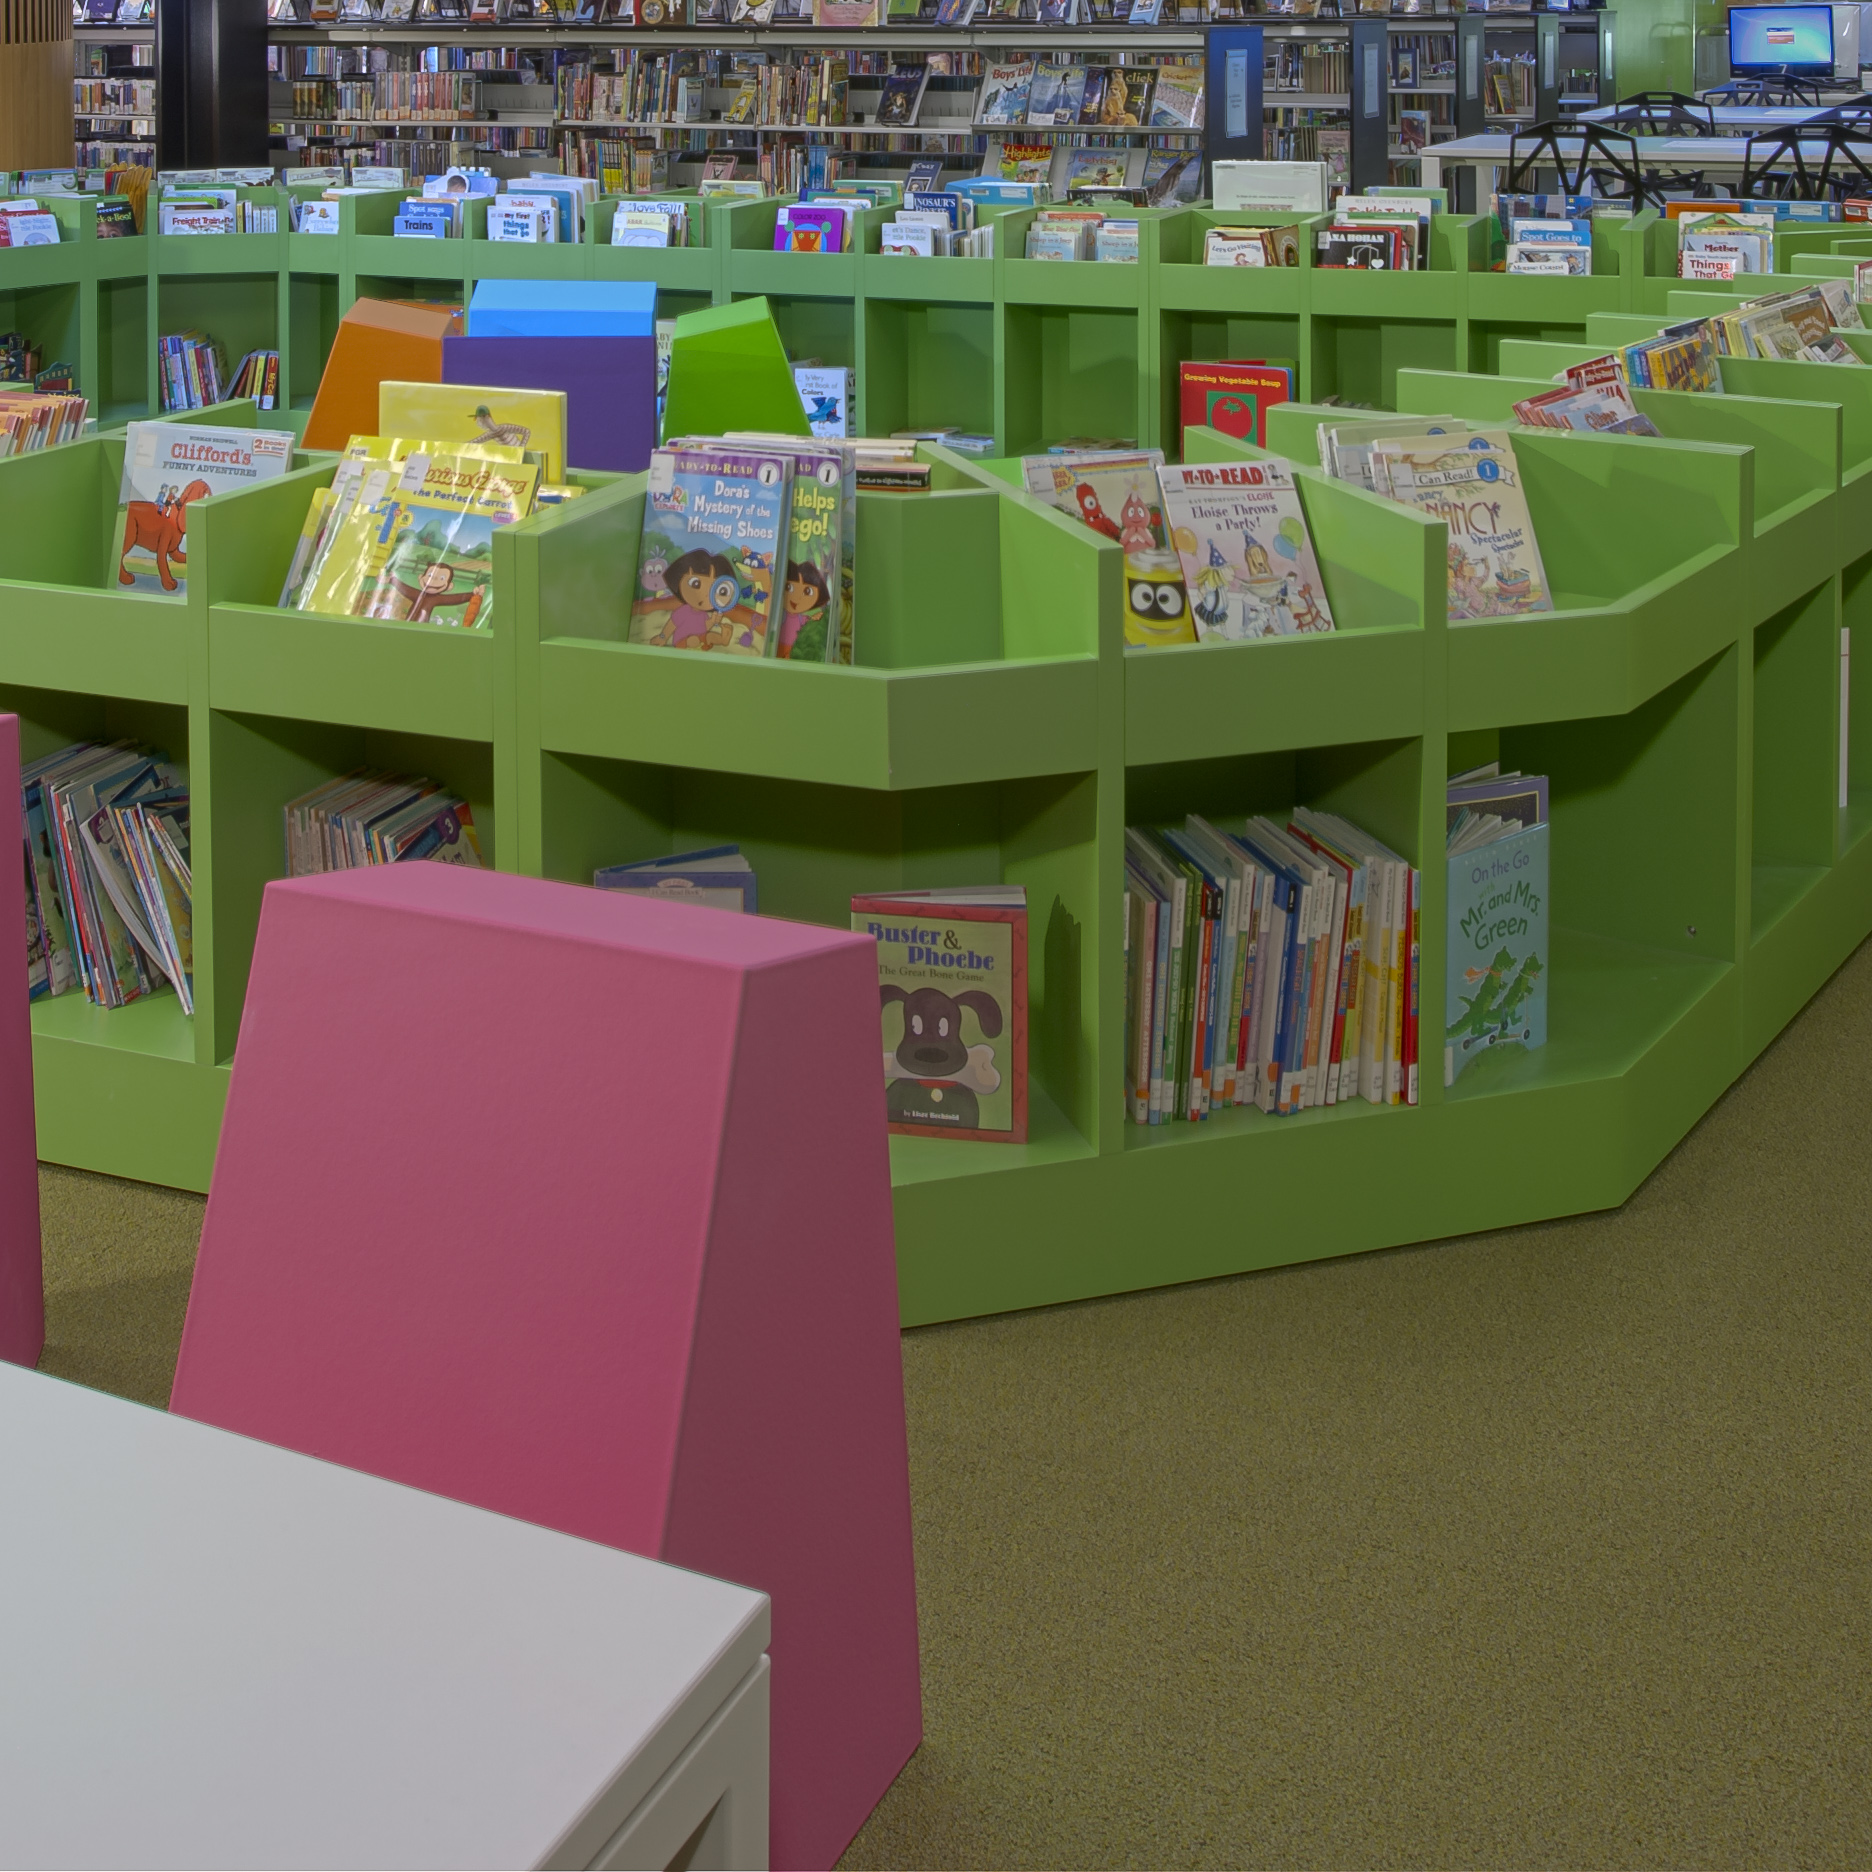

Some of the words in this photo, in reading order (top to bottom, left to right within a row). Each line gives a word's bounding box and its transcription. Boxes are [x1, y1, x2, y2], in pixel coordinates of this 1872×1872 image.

[1126, 71, 1153, 84] click
[1779, 64, 1787, 74] 7
[1004, 145, 1051, 160] Highlights
[172, 216, 199, 228] Freight
[201, 216, 220, 225] Train
[404, 220, 434, 231] Trains
[503, 220, 530, 230] things
[1348, 234, 1384, 243] HOBAN
[1522, 232, 1543, 242] Spot
[1546, 232, 1569, 242] Goes
[1572, 234, 1582, 242] to
[1704, 244, 1739, 252] Mother
[1690, 259, 1731, 272] Things
[1694, 270, 1717, 280] That
[1184, 373, 1217, 383] Growing
[1219, 375, 1258, 386] Vegetable
[1261, 378, 1281, 388] Soup
[254, 438, 264, 449] 2
[170, 442, 252, 466] Clifford's
[163, 461, 195, 472] FUNNY
[197, 464, 257, 477] ADVENTURES
[674, 460, 753, 475] EADY-TO-READ
[765, 468, 771, 484] 1
[825, 469, 831, 483] 1
[1484, 461, 1492, 477] 1
[424, 466, 472, 489] urious
[470, 470, 529, 498] George
[1419, 473, 1440, 485] Can
[1442, 468, 1474, 482] Read!
[714, 480, 750, 499] Dora's
[434, 490, 474, 504] Perfect
[477, 495, 512, 509] Carrot
[694, 494, 744, 519] Mystery
[745, 506, 755, 516] of
[757, 506, 771, 518] the
[793, 487, 835, 516] Helps
[1191, 504, 1229, 519] Eloise
[1235, 501, 1279, 518] Throws
[1425, 501, 1502, 536] NANCY
[688, 516, 733, 540] Missing
[736, 521, 774, 540] Shoes
[1227, 516, 1262, 534] Party!
[1470, 527, 1523, 545] Spectacular
[1472, 866, 1489, 884] On
[1491, 859, 1510, 877] the
[1513, 849, 1529, 870] Go
[1460, 901, 1488, 939] Mr.
[1489, 884, 1512, 912] and
[1514, 880, 1541, 917] Mrs.
[867, 922, 941, 946] Buster
[943, 928, 962, 951] &
[1475, 916, 1528, 951] Green
[907, 944, 995, 971] Phoebe
[878, 964, 897, 976] The
[899, 967, 926, 978] Great
[929, 969, 955, 981] Bone
[958, 971, 984, 983] Game
[1143, 982, 1152, 1026] SATURDAY
[1141, 1030, 1150, 1083] AFTERNOON
[903, 1109, 911, 1118] by
